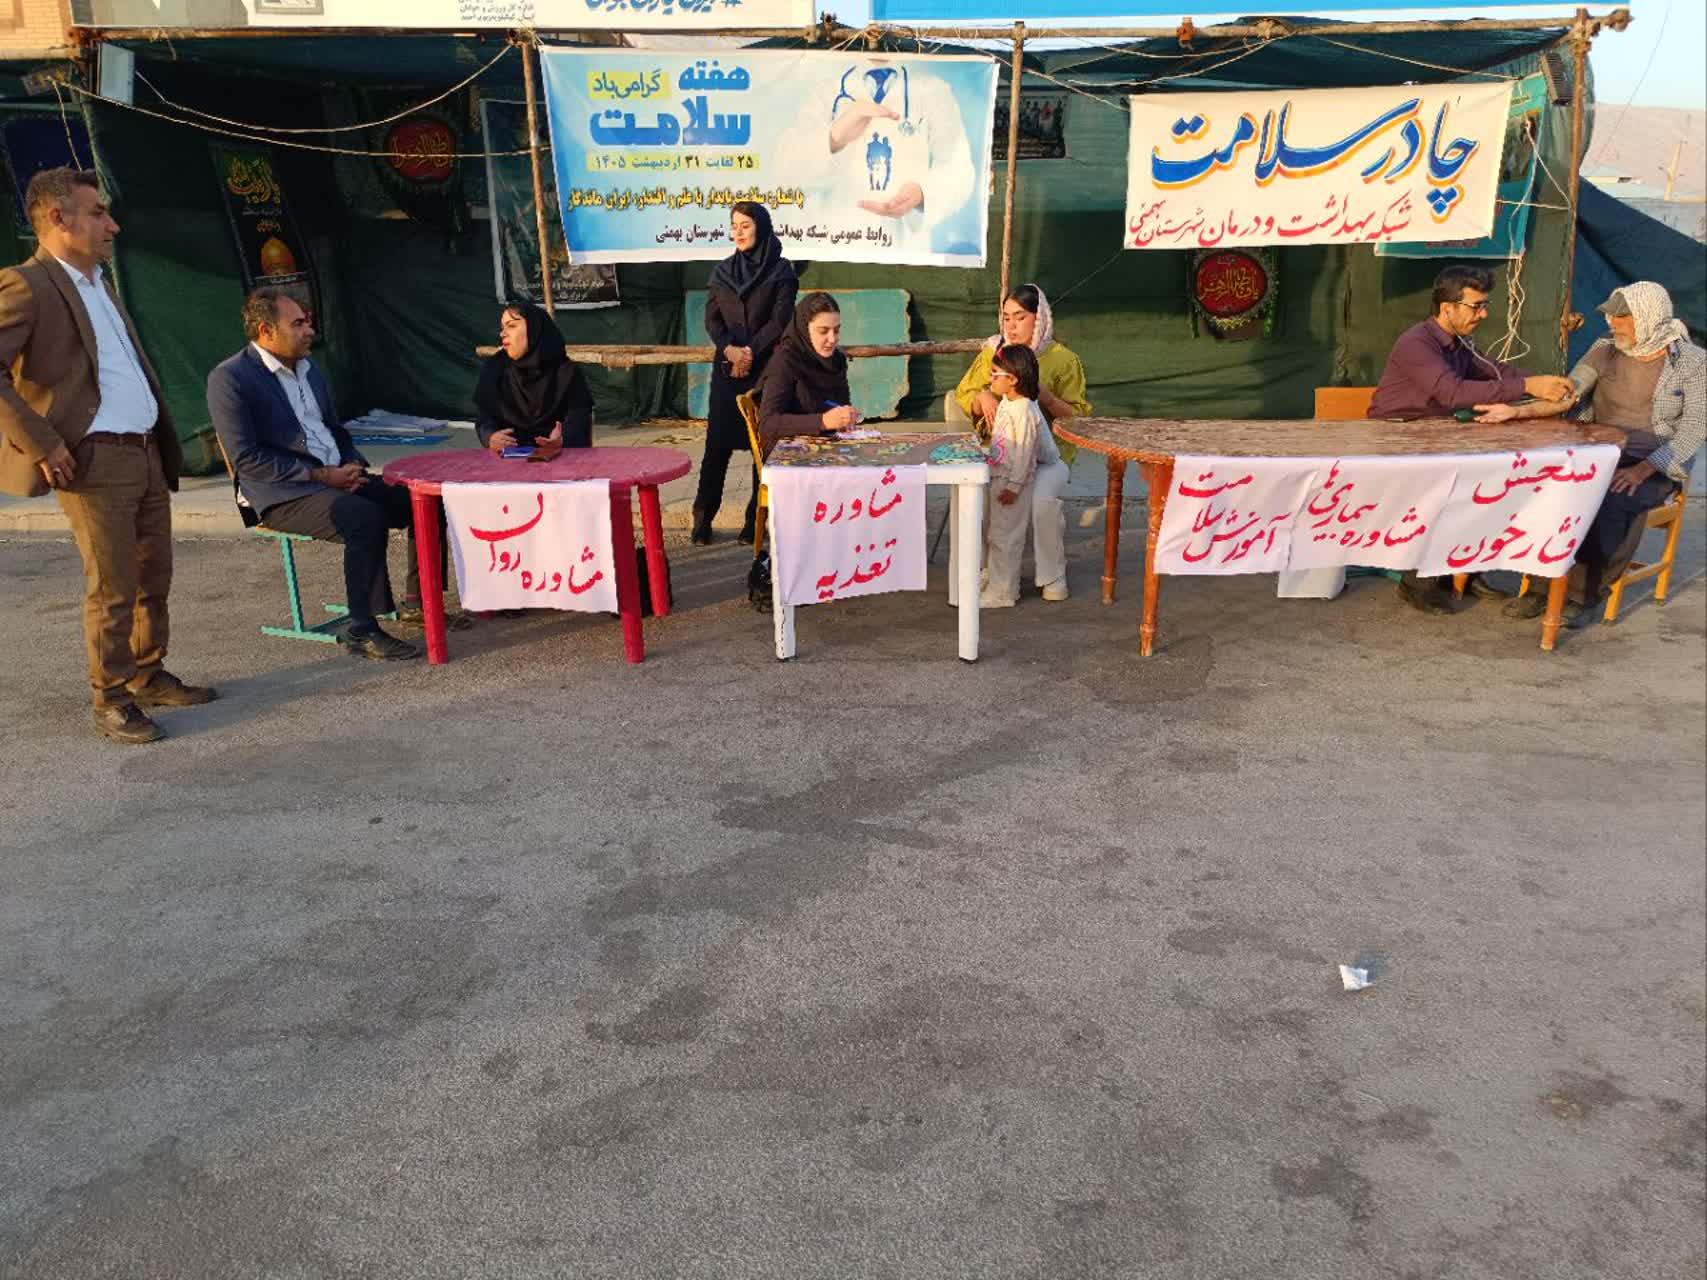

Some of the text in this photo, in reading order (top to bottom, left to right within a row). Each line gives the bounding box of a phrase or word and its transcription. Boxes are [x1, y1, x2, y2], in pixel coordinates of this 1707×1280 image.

[593, 68, 662, 99] گرامی باد
[678, 60, 750, 90] هفته
[590, 96, 751, 145] سلامت
[595, 155, 754, 171] ۲۵ لغایت ۳۱ اردیبهشت ۱۴۰۵
[1151, 97, 1482, 225] چادر سلامت
[655, 225, 683, 243] بهمنی
[686, 224, 725, 243] شهرستان
[806, 225, 829, 242] شبکه
[830, 226, 863, 245] عمومی
[1134, 207, 1206, 248] شهرستان
[1197, 208, 1262, 248] درمان
[1262, 214, 1275, 236] و
[1277, 191, 1376, 242] بهداشت
[1364, 188, 1413, 242] شبکه
[866, 226, 893, 247] روابط
[812, 467, 903, 525] مشاوره
[1472, 449, 1598, 505] سنجش
[1178, 471, 1293, 565] آموزش سلامت
[1339, 506, 1427, 549] مشاوره
[1446, 512, 1583, 569] فشار خون
[520, 545, 604, 595] مشاوره
[814, 537, 898, 600] تغذیه
